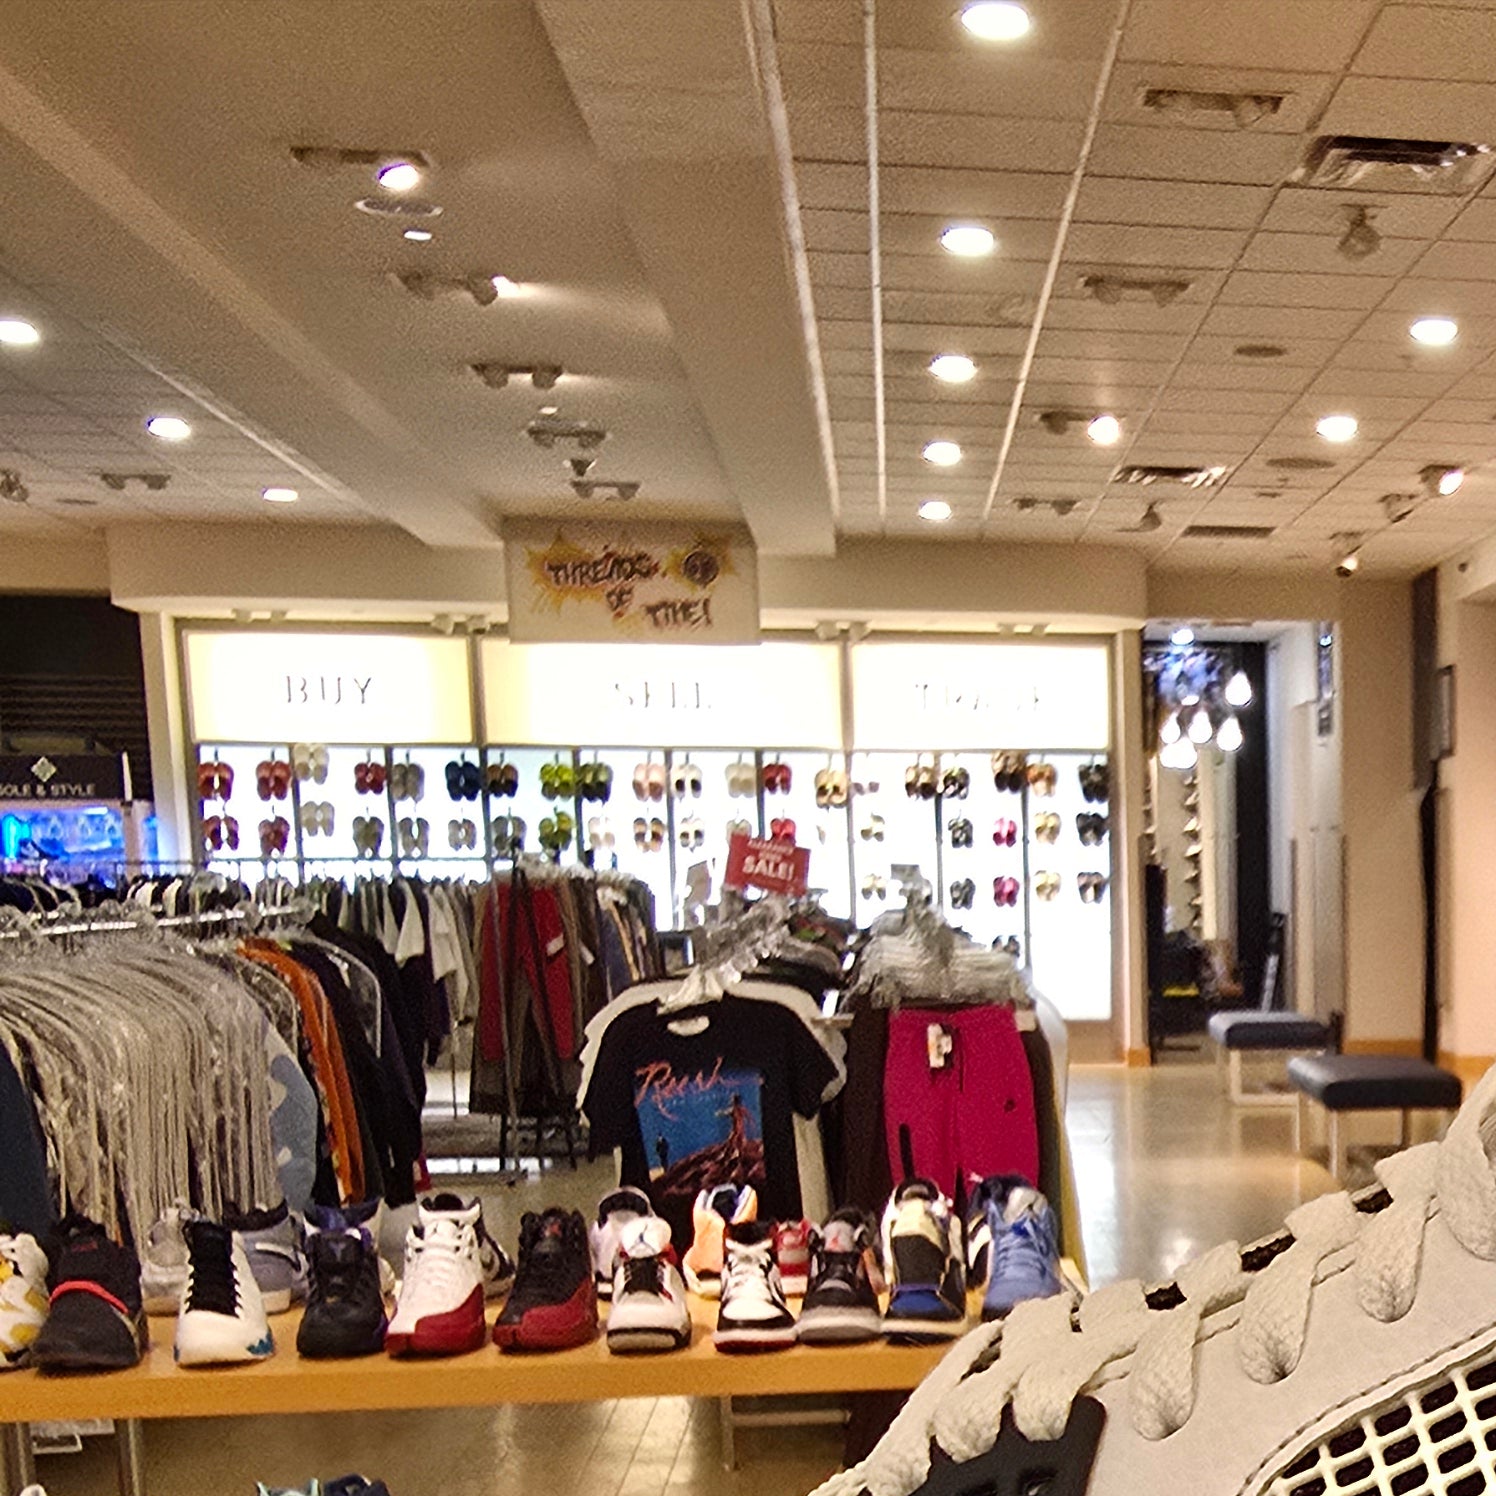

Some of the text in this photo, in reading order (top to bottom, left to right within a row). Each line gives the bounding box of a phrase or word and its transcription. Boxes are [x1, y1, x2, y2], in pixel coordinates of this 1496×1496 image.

[286, 675, 372, 705] BUY
[51, 783, 96, 797] STYLE
[742, 855, 795, 882] SALE!
